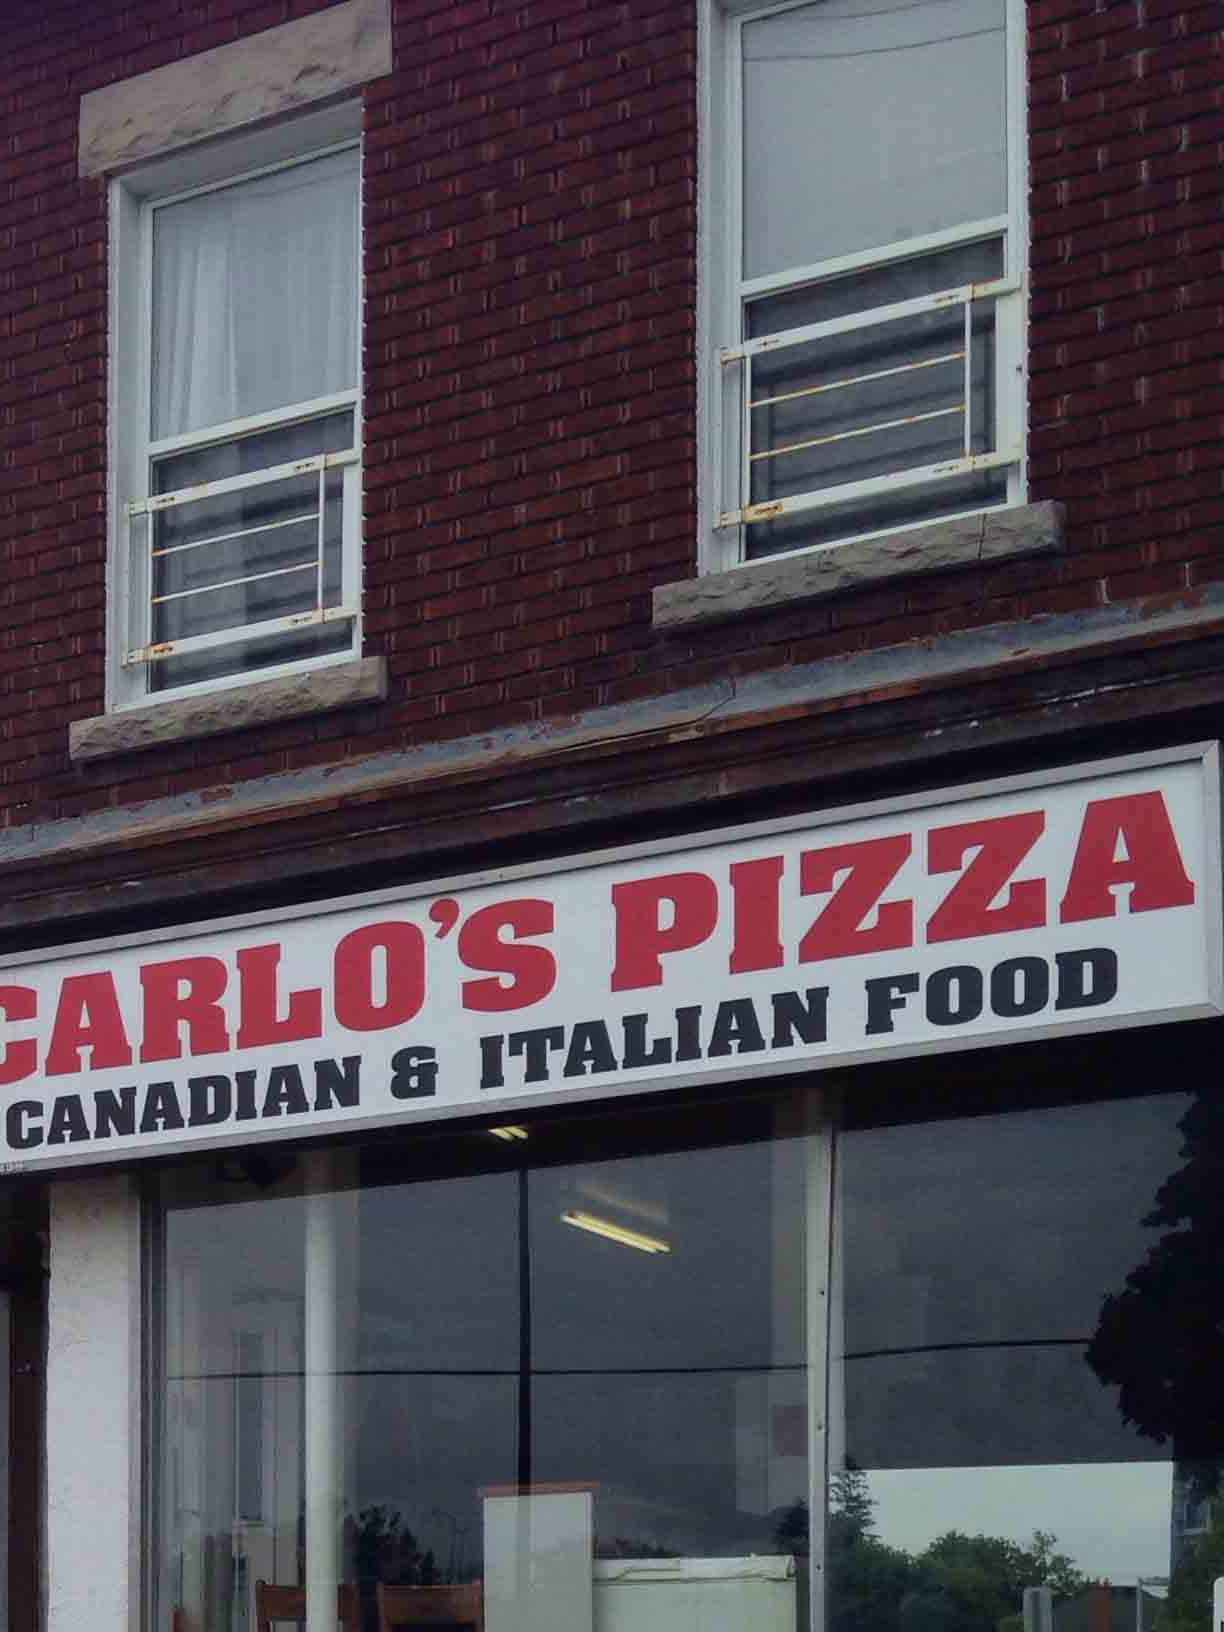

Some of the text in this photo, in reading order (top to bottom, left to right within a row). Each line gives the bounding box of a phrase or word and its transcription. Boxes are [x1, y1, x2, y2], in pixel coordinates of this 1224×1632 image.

[610, 790, 1196, 992] PIZZA
[5, 947, 1119, 1150] CANADIAN & ITALIAN FOOD
